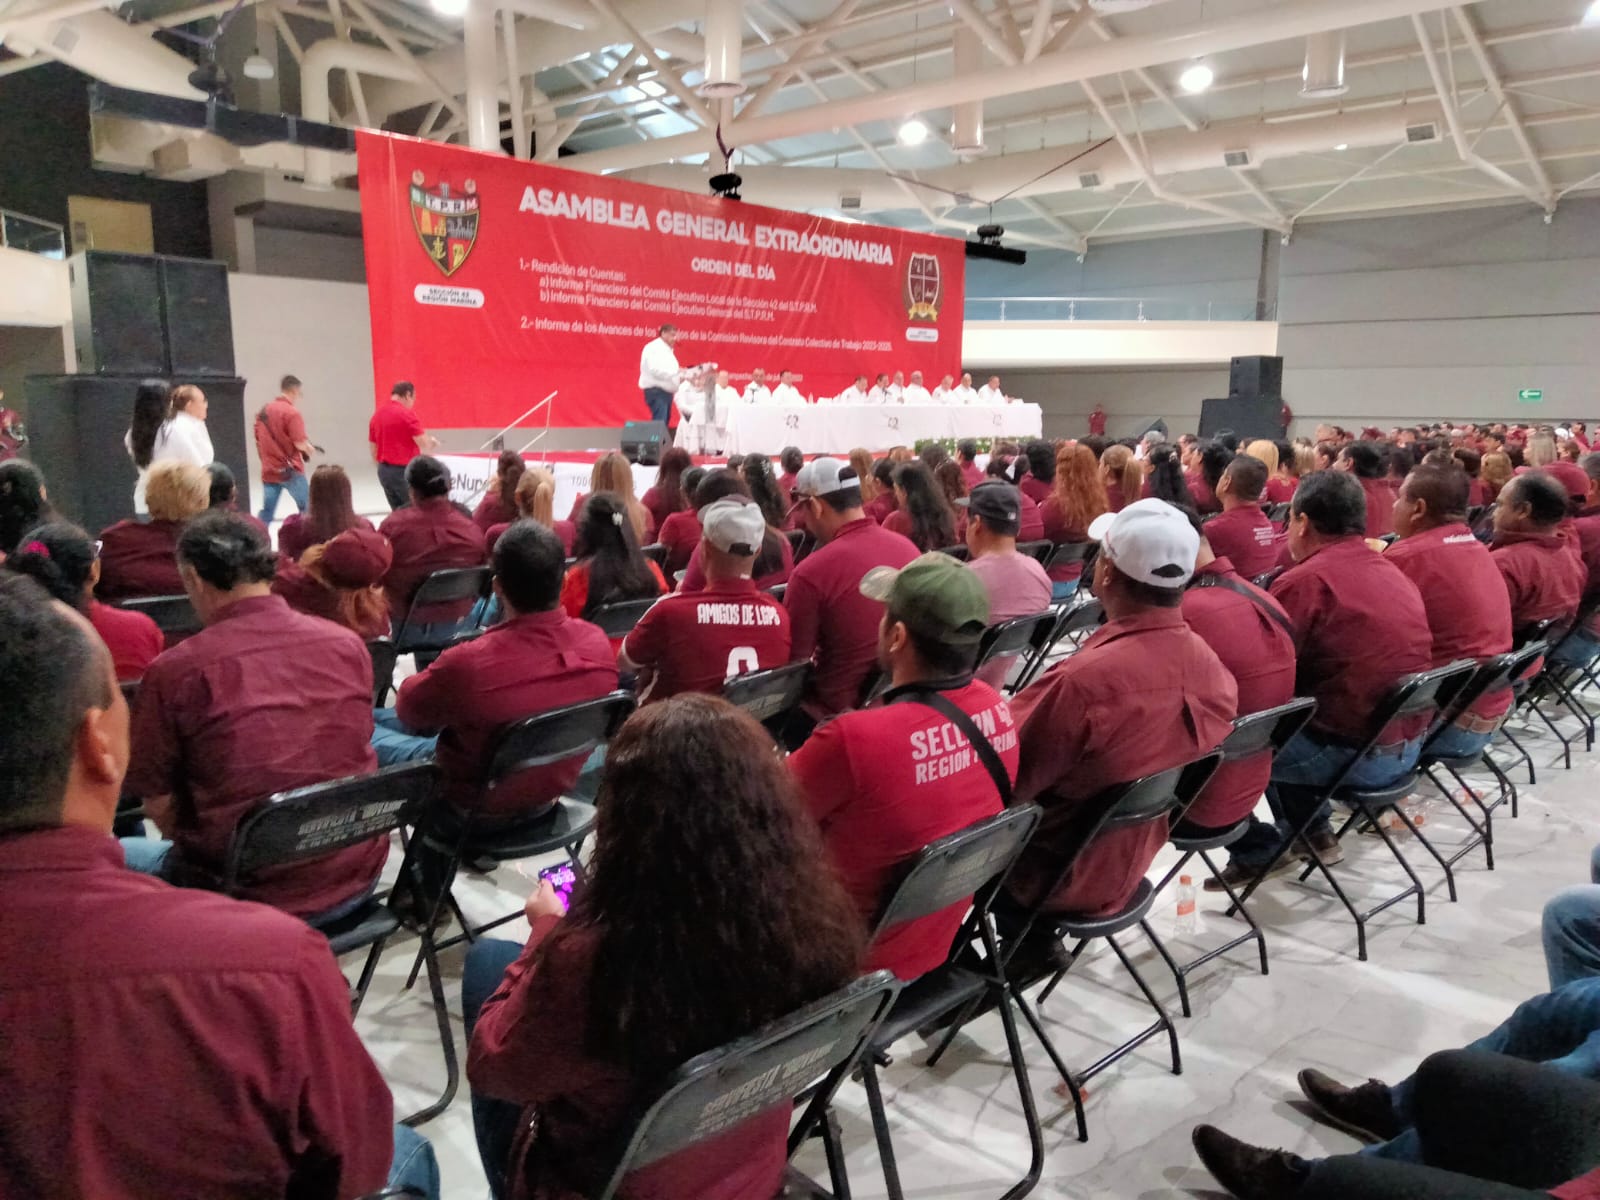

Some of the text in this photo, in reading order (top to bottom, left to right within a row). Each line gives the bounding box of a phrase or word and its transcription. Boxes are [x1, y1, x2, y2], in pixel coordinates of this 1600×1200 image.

[519, 185, 893, 266] ASAMBLEA GENERAL EXTRAORDINARIA
[531, 258, 575, 276] Rendición
[577, 264, 588, 277] de
[589, 266, 627, 282] Cuentas:
[690, 257, 776, 281] ORDEN DEL DÍA
[540, 289, 549, 304] b)
[550, 290, 584, 305] Informe
[586, 294, 629, 309] Financiero
[630, 298, 643, 310] del
[671, 302, 705, 316] Ejecutivo
[706, 306, 733, 318] General
[733, 308, 743, 319] del
[549, 275, 584, 291] Informe
[585, 280, 629, 296] Financiero
[630, 285, 643, 297] del
[671, 288, 705, 303] Ejecutivo
[769, 298, 778, 310] 42
[779, 300, 788, 311] del
[535, 317, 570, 331] Informe
[571, 321, 583, 333] de
[584, 321, 597, 334] los
[598, 322, 632, 336] Avances
[633, 325, 644, 337] de
[645, 326, 656, 338] los
[689, 330, 699, 340] de
[700, 330, 707, 340] la
[841, 339, 862, 351] Trabajo
[697, 603, 740, 625] AMIGOS
[741, 604, 755, 626] DE
[915, 747, 971, 785] REGION
